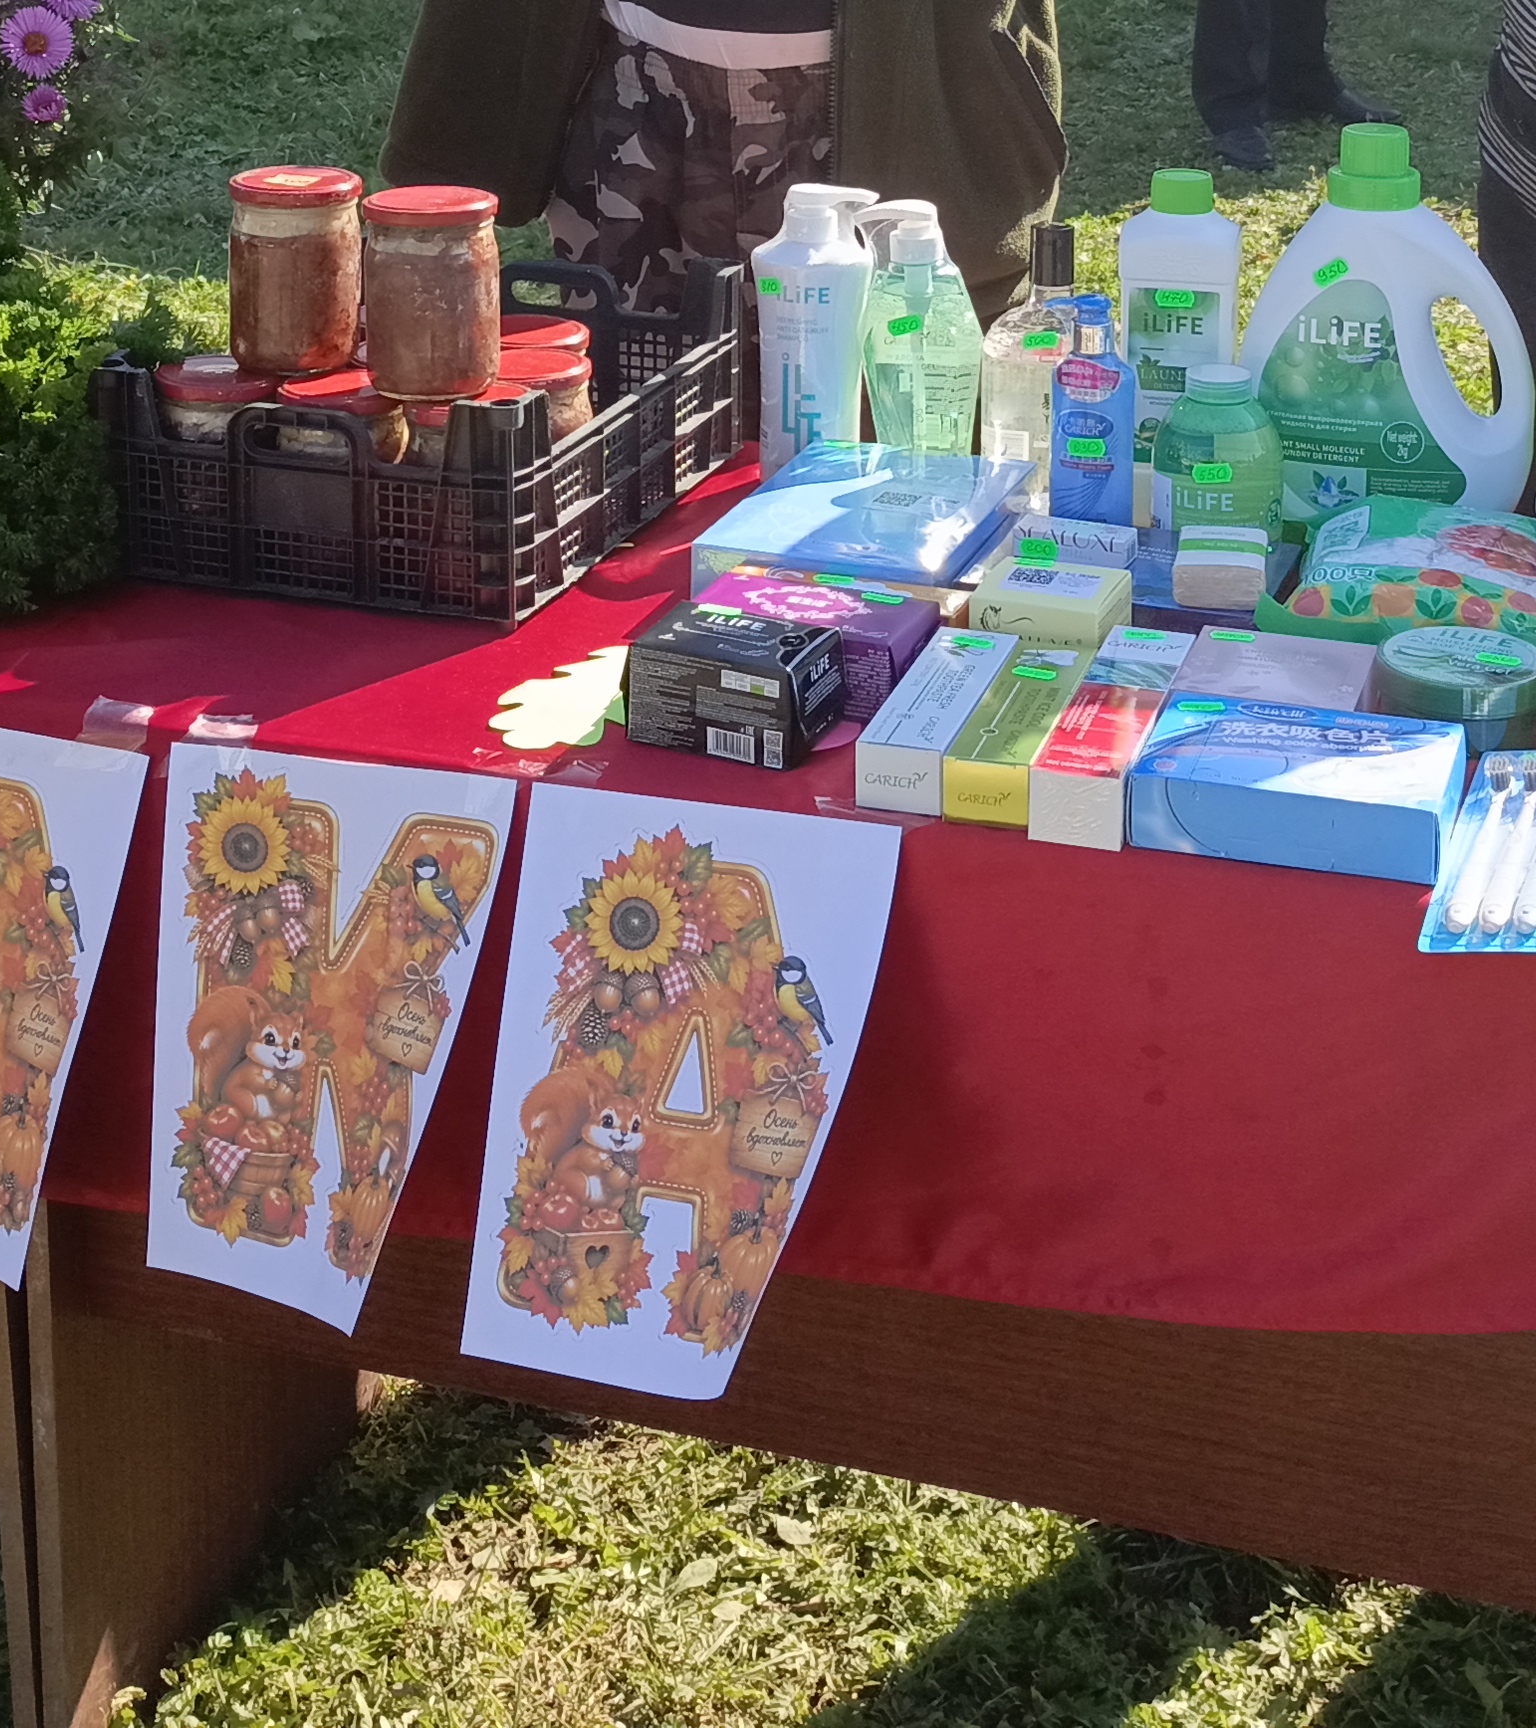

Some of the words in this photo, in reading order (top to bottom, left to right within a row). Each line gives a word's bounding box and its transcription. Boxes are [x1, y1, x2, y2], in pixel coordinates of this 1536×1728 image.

[1317, 259, 1349, 282] 950
[892, 319, 919, 333] 450
[1143, 312, 1204, 336] iLiFE
[1298, 314, 1382, 349] iLiFE
[1025, 333, 1053, 348] 500
[1295, 441, 1322, 453] SMALL
[1322, 445, 1365, 456] MOLECULE
[1312, 452, 1360, 463] DETERGENT
[1176, 486, 1234, 512] iLiFE
[1439, 628, 1518, 649] iLiFE
[809, 653, 831, 683] iLiFE
[1222, 721, 1390, 745] 洗衣吸色片
[1222, 736, 1281, 747] Washing
[1284, 739, 1317, 748] color
[864, 772, 929, 790] CARICH
[957, 792, 1012, 808] CARICH
[764, 1108, 799, 1130] Осень
